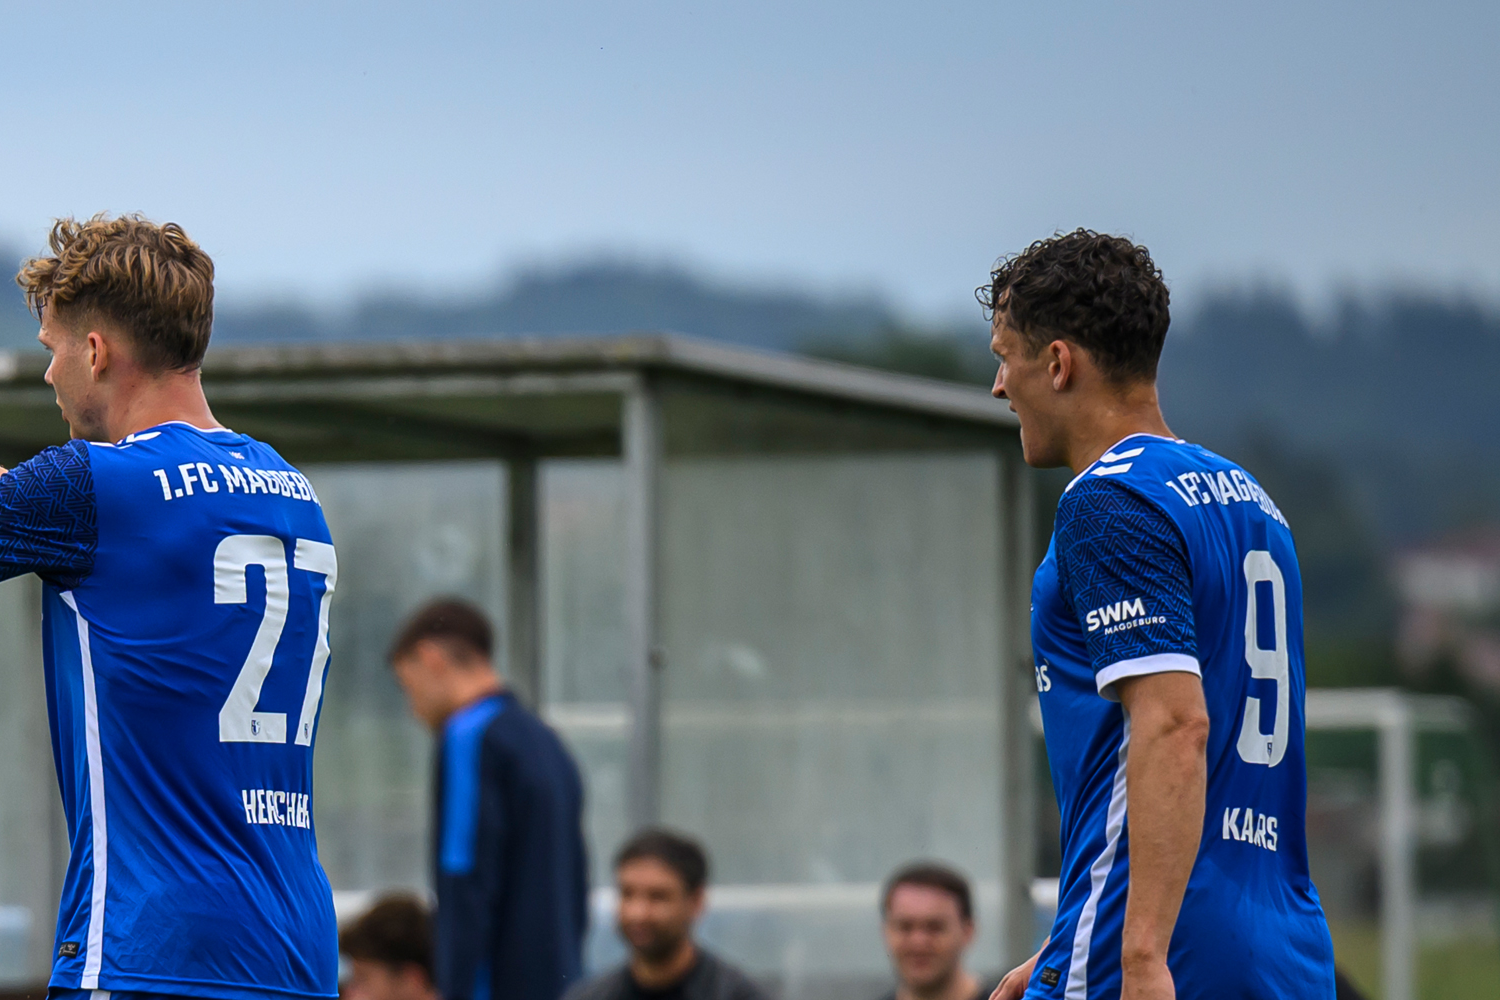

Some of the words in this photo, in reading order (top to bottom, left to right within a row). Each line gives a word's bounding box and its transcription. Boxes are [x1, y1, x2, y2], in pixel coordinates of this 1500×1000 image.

[153, 462, 219, 501] 1.FC
[1086, 597, 1146, 632] SWM
[1104, 616, 1167, 635] MAGDEBURG
[213, 534, 338, 747] 27
[1236, 550, 1289, 768] 9
